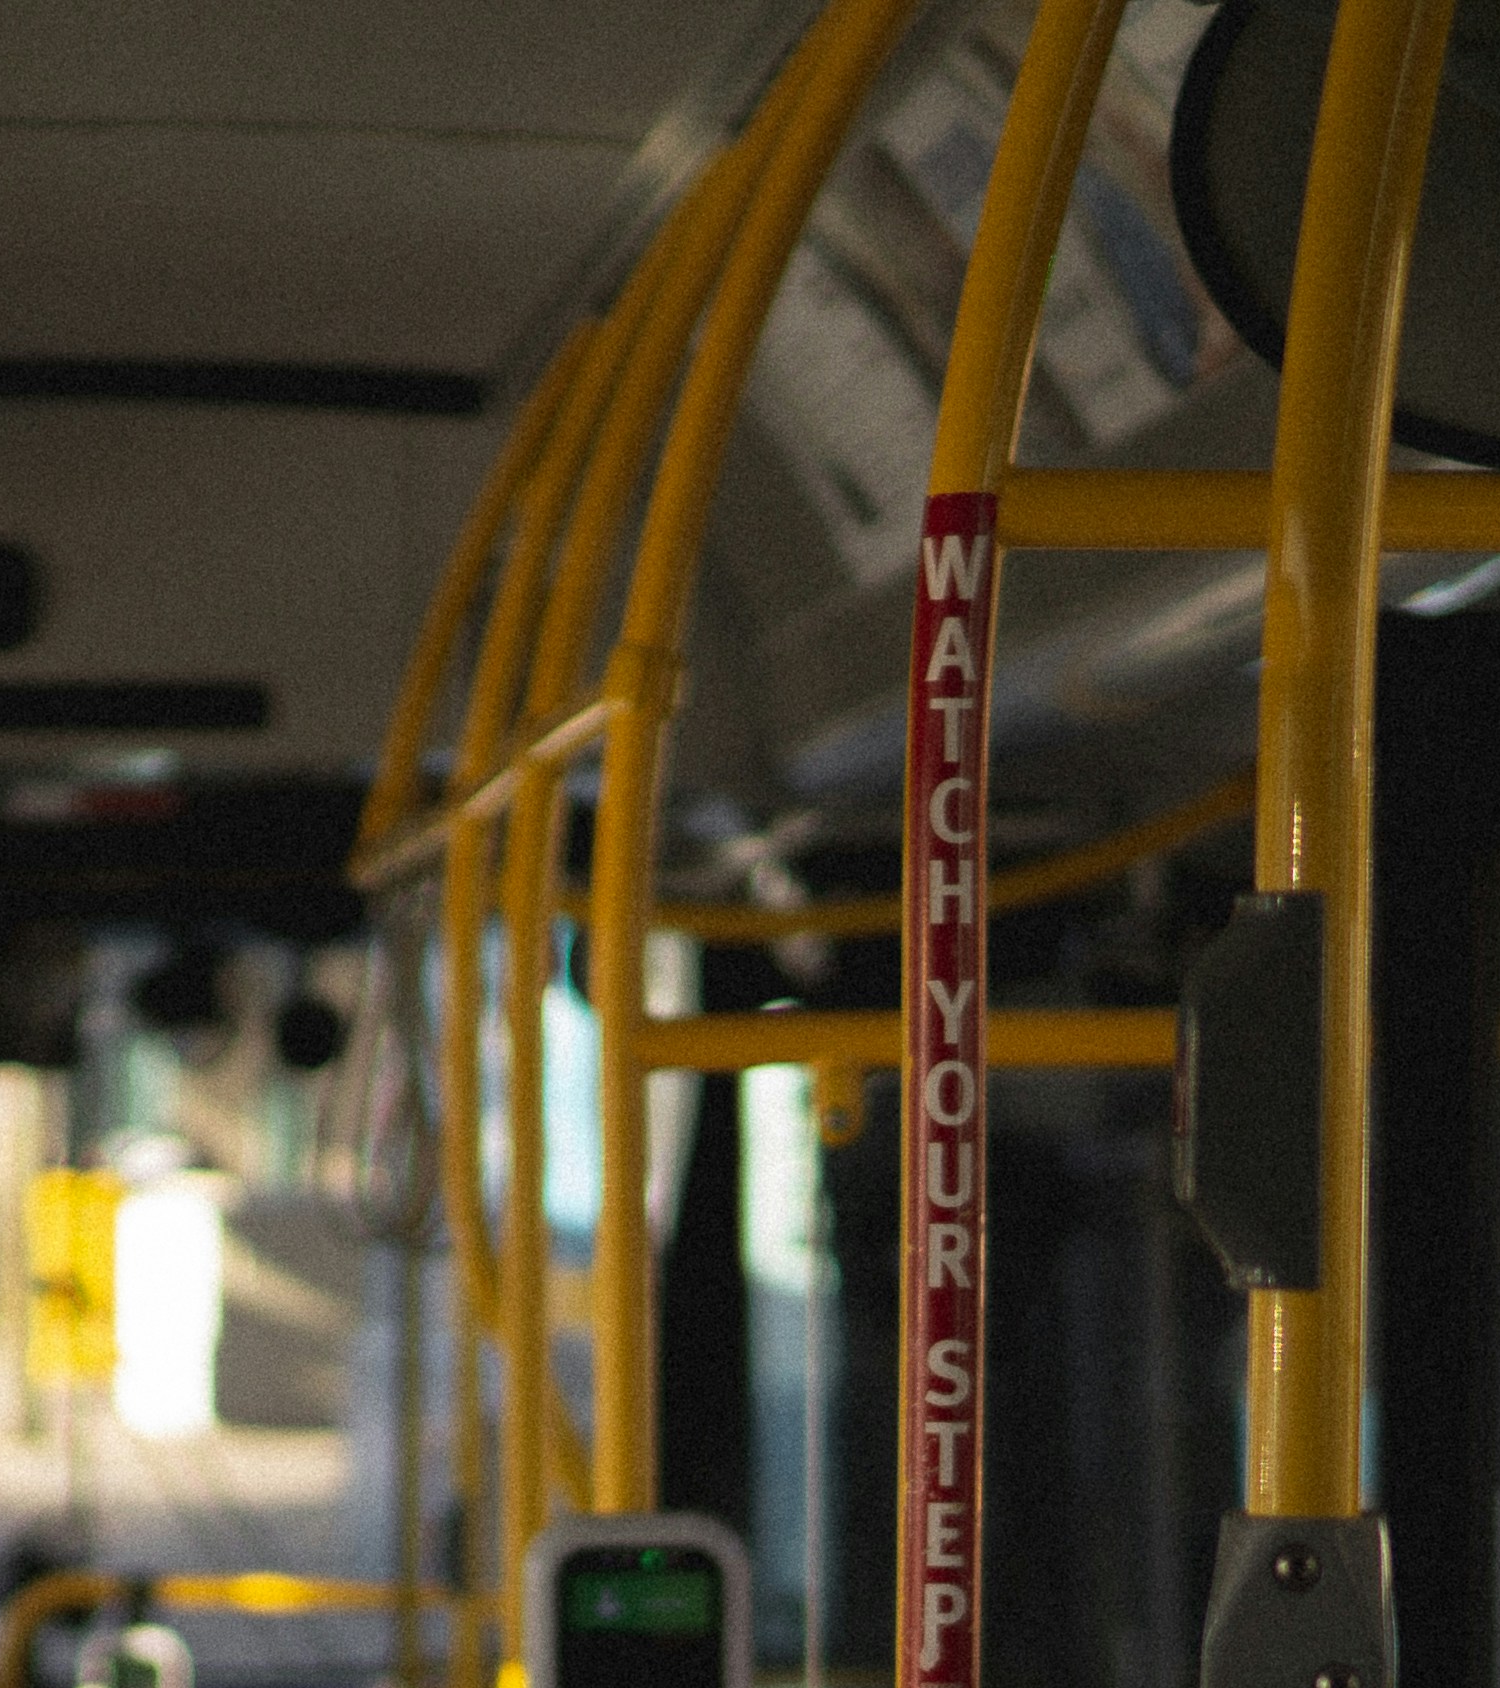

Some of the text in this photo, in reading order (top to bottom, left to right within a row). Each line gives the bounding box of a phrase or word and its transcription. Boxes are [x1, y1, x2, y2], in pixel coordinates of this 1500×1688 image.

[922, 533, 984, 925] WATCH
[925, 979, 976, 1289] YOUR
[920, 1340, 970, 1671] STEP
